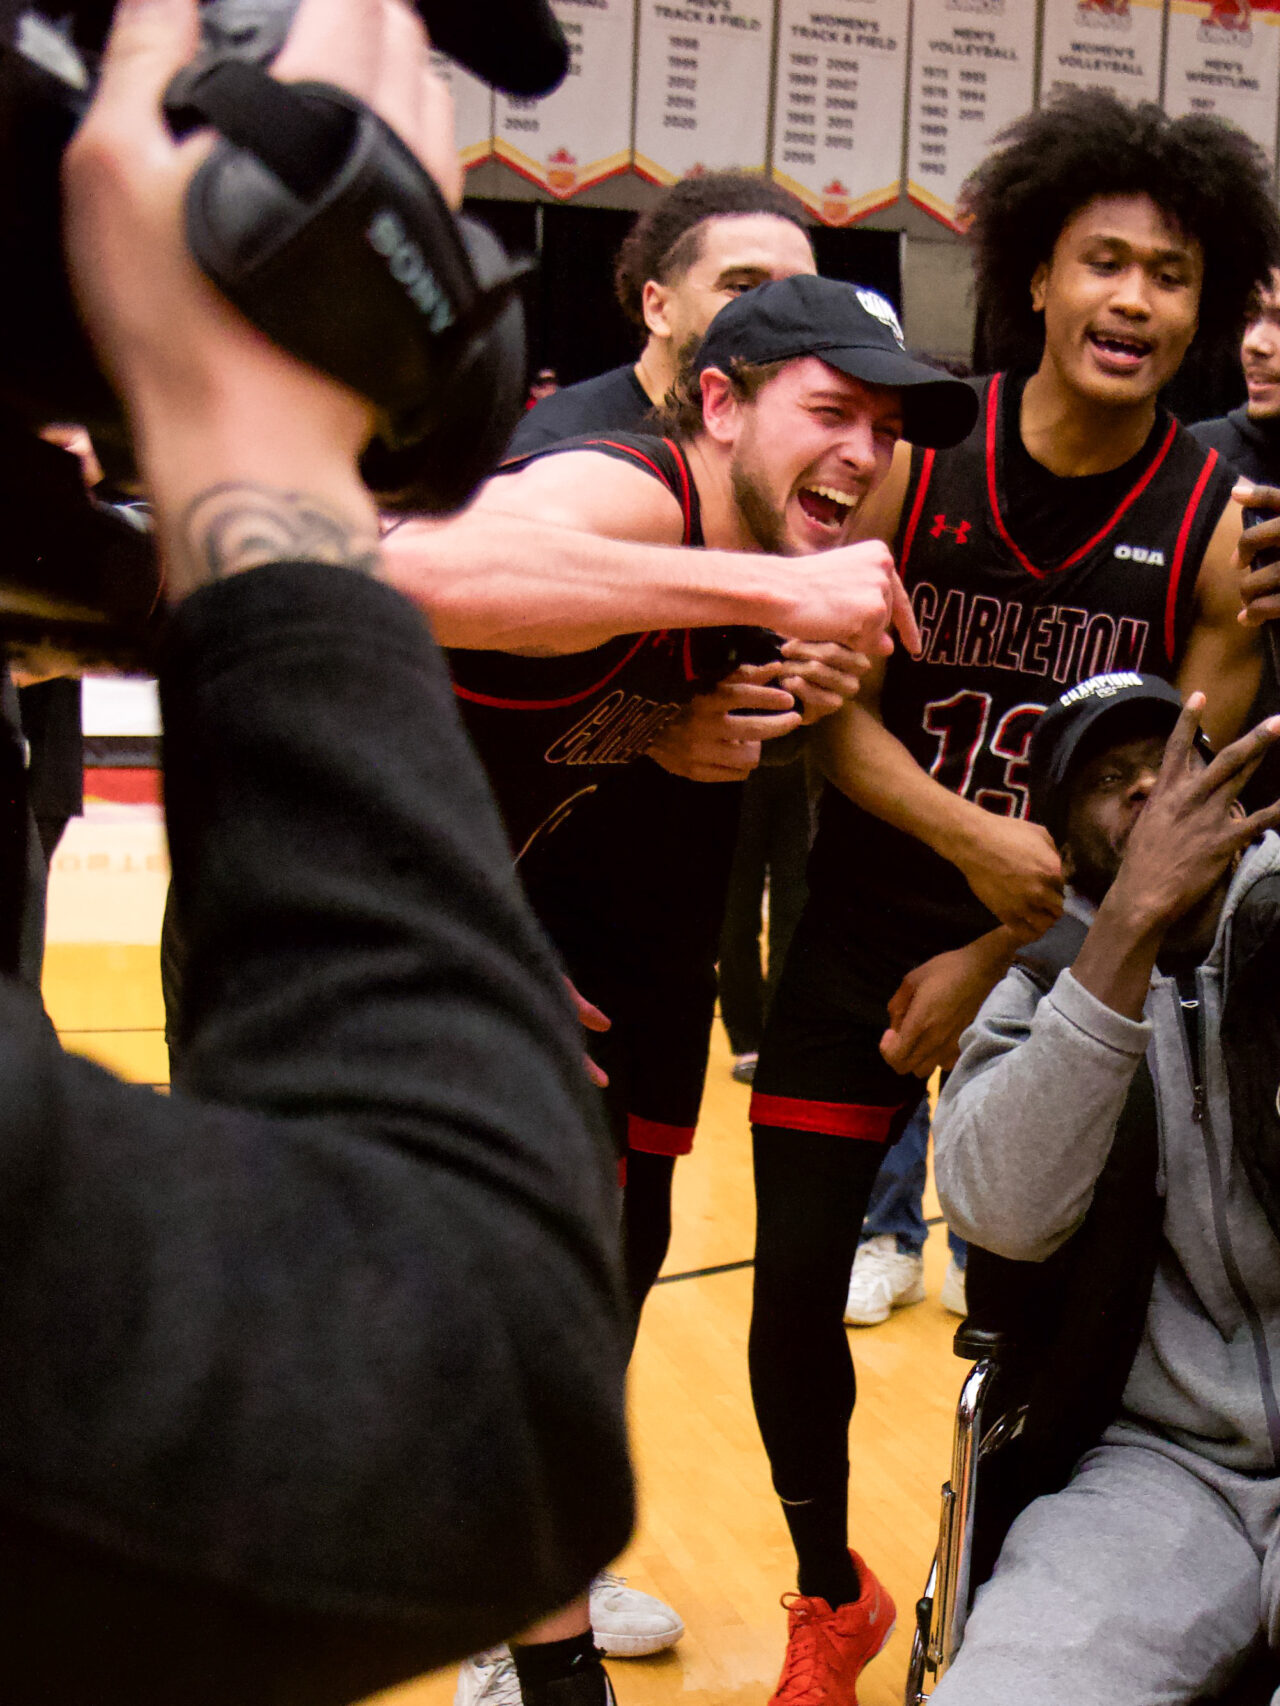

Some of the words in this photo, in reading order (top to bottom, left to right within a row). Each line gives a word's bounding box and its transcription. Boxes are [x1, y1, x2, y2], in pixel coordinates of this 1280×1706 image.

[655, 5, 701, 21] TRACK
[720, 14, 761, 31] FIELD
[810, 14, 879, 32] WOMEN'S
[791, 25, 838, 41] TRACK
[856, 35, 897, 51] FIELD
[953, 28, 995, 42] MEN'S
[929, 41, 1017, 61] VOLLEYBALL
[1071, 42, 1135, 59] WOMEN'S
[1058, 55, 1143, 76] VOLLEYBALL
[1205, 59, 1243, 74] MEN'S
[1186, 71, 1259, 91] WRESTLING
[368, 211, 453, 333] SONY
[1114, 544, 1165, 566] OUA
[911, 582, 1149, 684] CARLETON
[1060, 671, 1144, 707] CHAMPIONS
